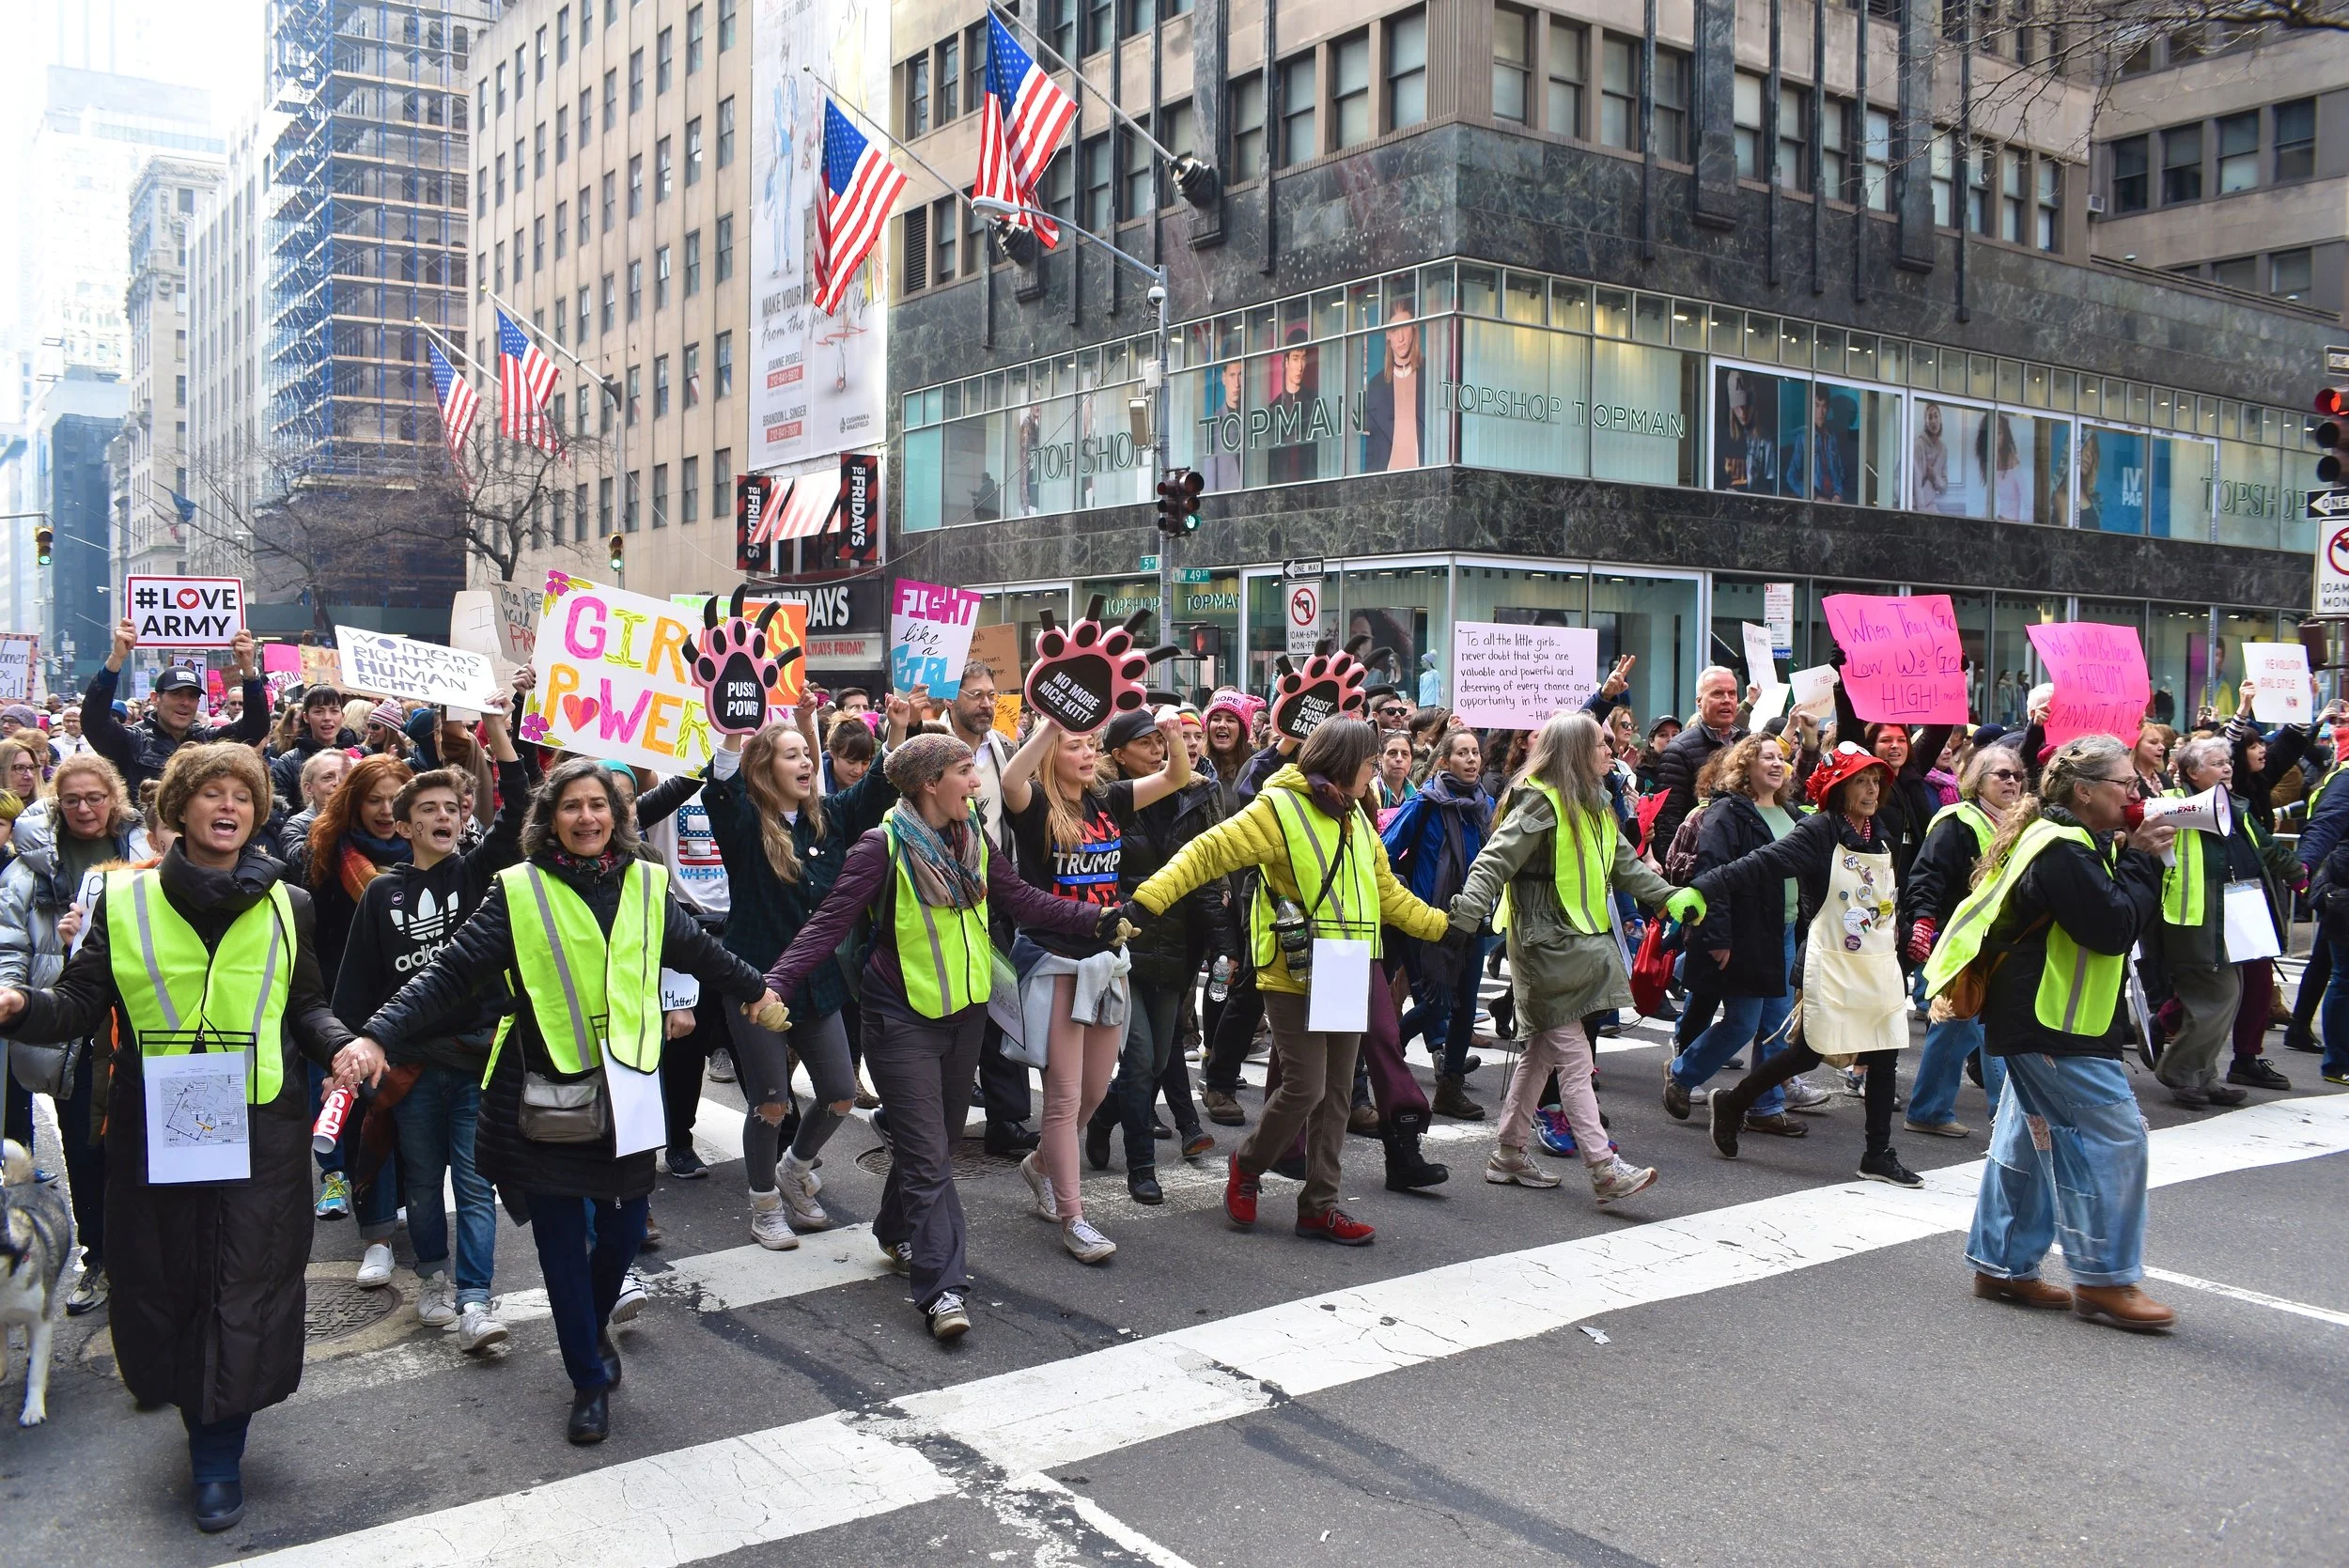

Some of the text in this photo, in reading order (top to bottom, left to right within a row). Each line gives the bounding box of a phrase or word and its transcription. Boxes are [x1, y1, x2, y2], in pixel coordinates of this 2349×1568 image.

[762, 294, 781, 318] MAKE
[782, 286, 801, 310] YOUR
[852, 286, 868, 319] Up
[1440, 381, 1686, 439] TOPSHOP TOPMAN
[1198, 390, 1367, 456] TOPMAN
[852, 466, 865, 475] TGI
[748, 487, 761, 495] TGI
[851, 475, 865, 548] FRIDAYS
[1143, 558, 1150, 570] 5
[1189, 569, 1202, 582] 49
[1294, 563, 1320, 573] ONE WAY
[490, 582, 521, 606] The
[894, 583, 980, 627] FIGHT
[140, 614, 232, 637] ARMY
[500, 603, 533, 630] Will
[900, 622, 942, 645] like
[1289, 630, 1318, 640] 10AM-6PM
[1483, 632, 1495, 646] all
[1495, 633, 1512, 645] the
[1515, 632, 1533, 646] little
[1836, 601, 1957, 658] When They Go
[922, 646, 938, 656] a
[1461, 649, 1569, 663] never doubt that you are
[2037, 631, 2133, 663] We Who Believe
[353, 644, 435, 669] RIGHTS
[443, 663, 479, 677] ARE
[891, 644, 962, 700] GIRL
[1849, 645, 1959, 678] Low, We Go
[355, 658, 468, 692] HUMAN
[1460, 665, 1574, 680] valuable and powerful and
[2077, 663, 2126, 696] FREEDOM
[2277, 678, 2296, 689] STYLE
[358, 674, 430, 695] RIGHTS
[726, 682, 756, 698] PUSSY
[1052, 671, 1100, 711] NO MORE
[1460, 679, 1590, 694] deserving of every chance and
[726, 700, 759, 717] POWER
[1037, 680, 1095, 724] NICE KITTY
[1214, 694, 1242, 708] NOPE!
[1301, 694, 1334, 713] PUSSY
[1460, 694, 1516, 710] opportunity
[1521, 695, 1531, 706] in
[1533, 693, 1548, 705] the
[1881, 683, 1938, 712] HIGH!
[2048, 703, 2109, 731] CANNOT
[1052, 849, 1121, 875] TRUMP
[664, 989, 696, 1008] Matter!
